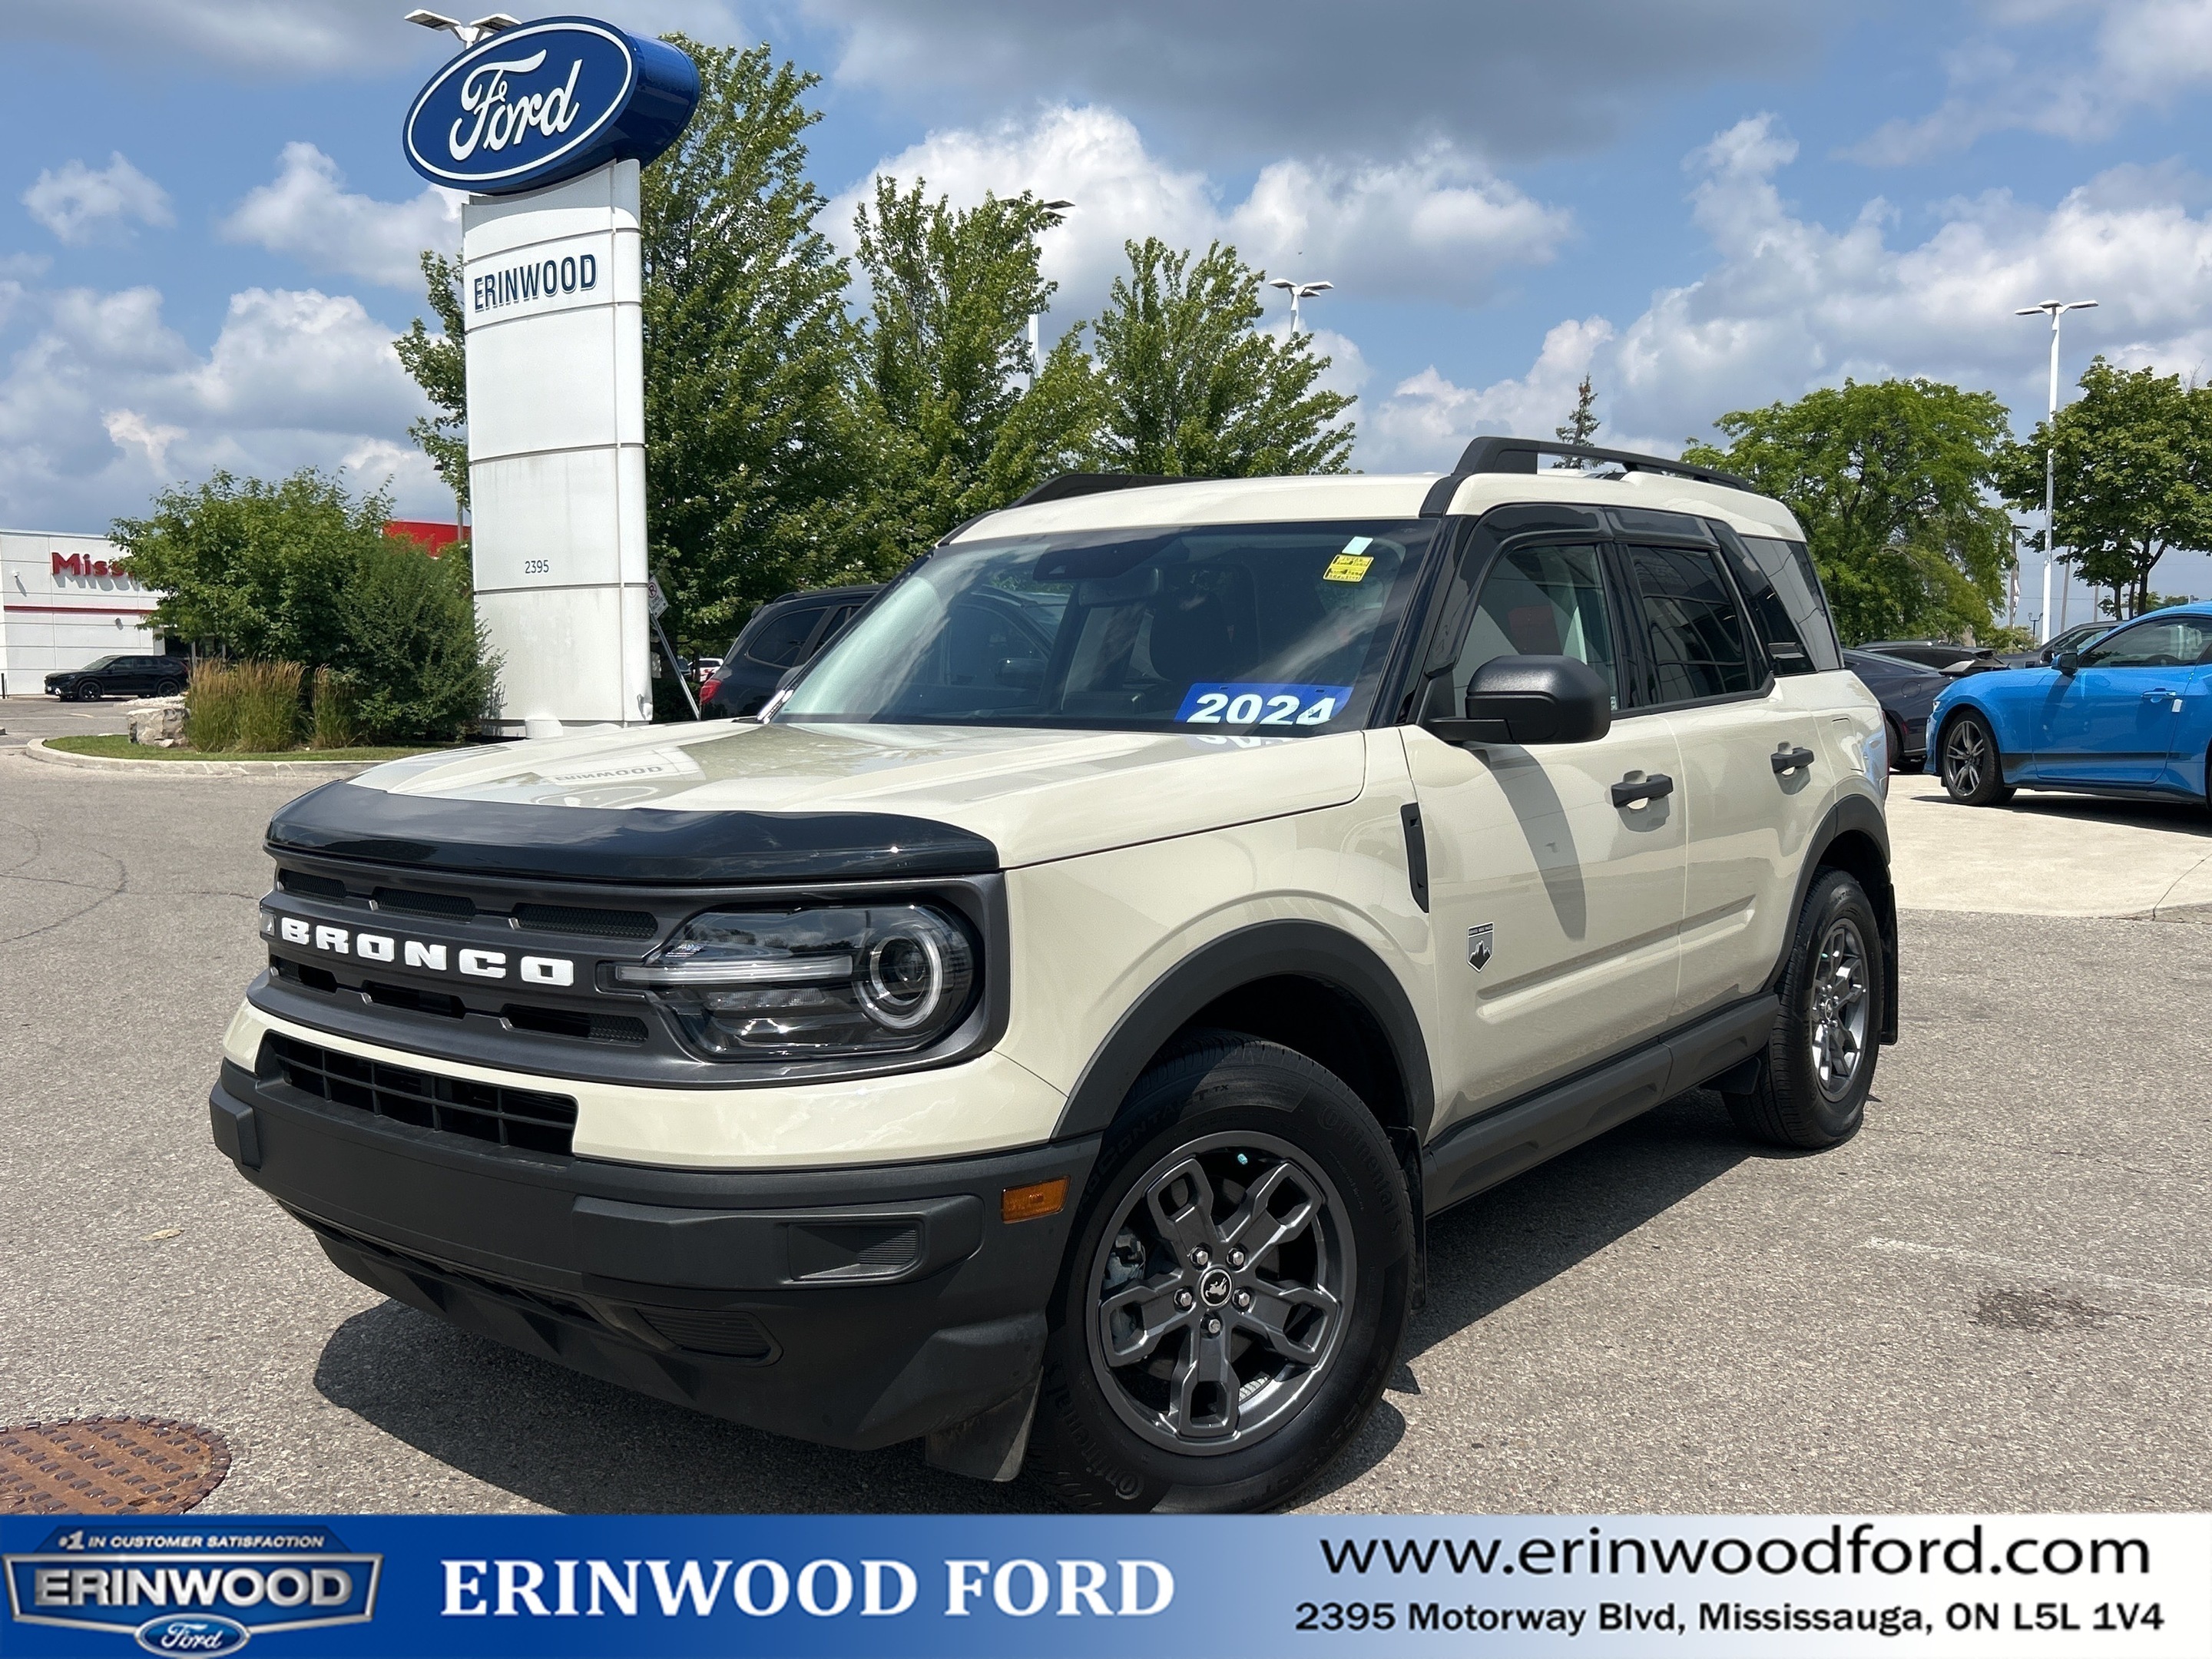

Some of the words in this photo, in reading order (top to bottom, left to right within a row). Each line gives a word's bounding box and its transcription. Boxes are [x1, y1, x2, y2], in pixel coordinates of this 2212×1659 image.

[449, 49, 583, 161] Ford
[474, 253, 598, 311] ERINWOOD
[51, 551, 134, 578] Miss
[525, 559, 550, 575] 2395
[1187, 693, 1336, 725] 2024
[281, 916, 574, 987] BRONCO
